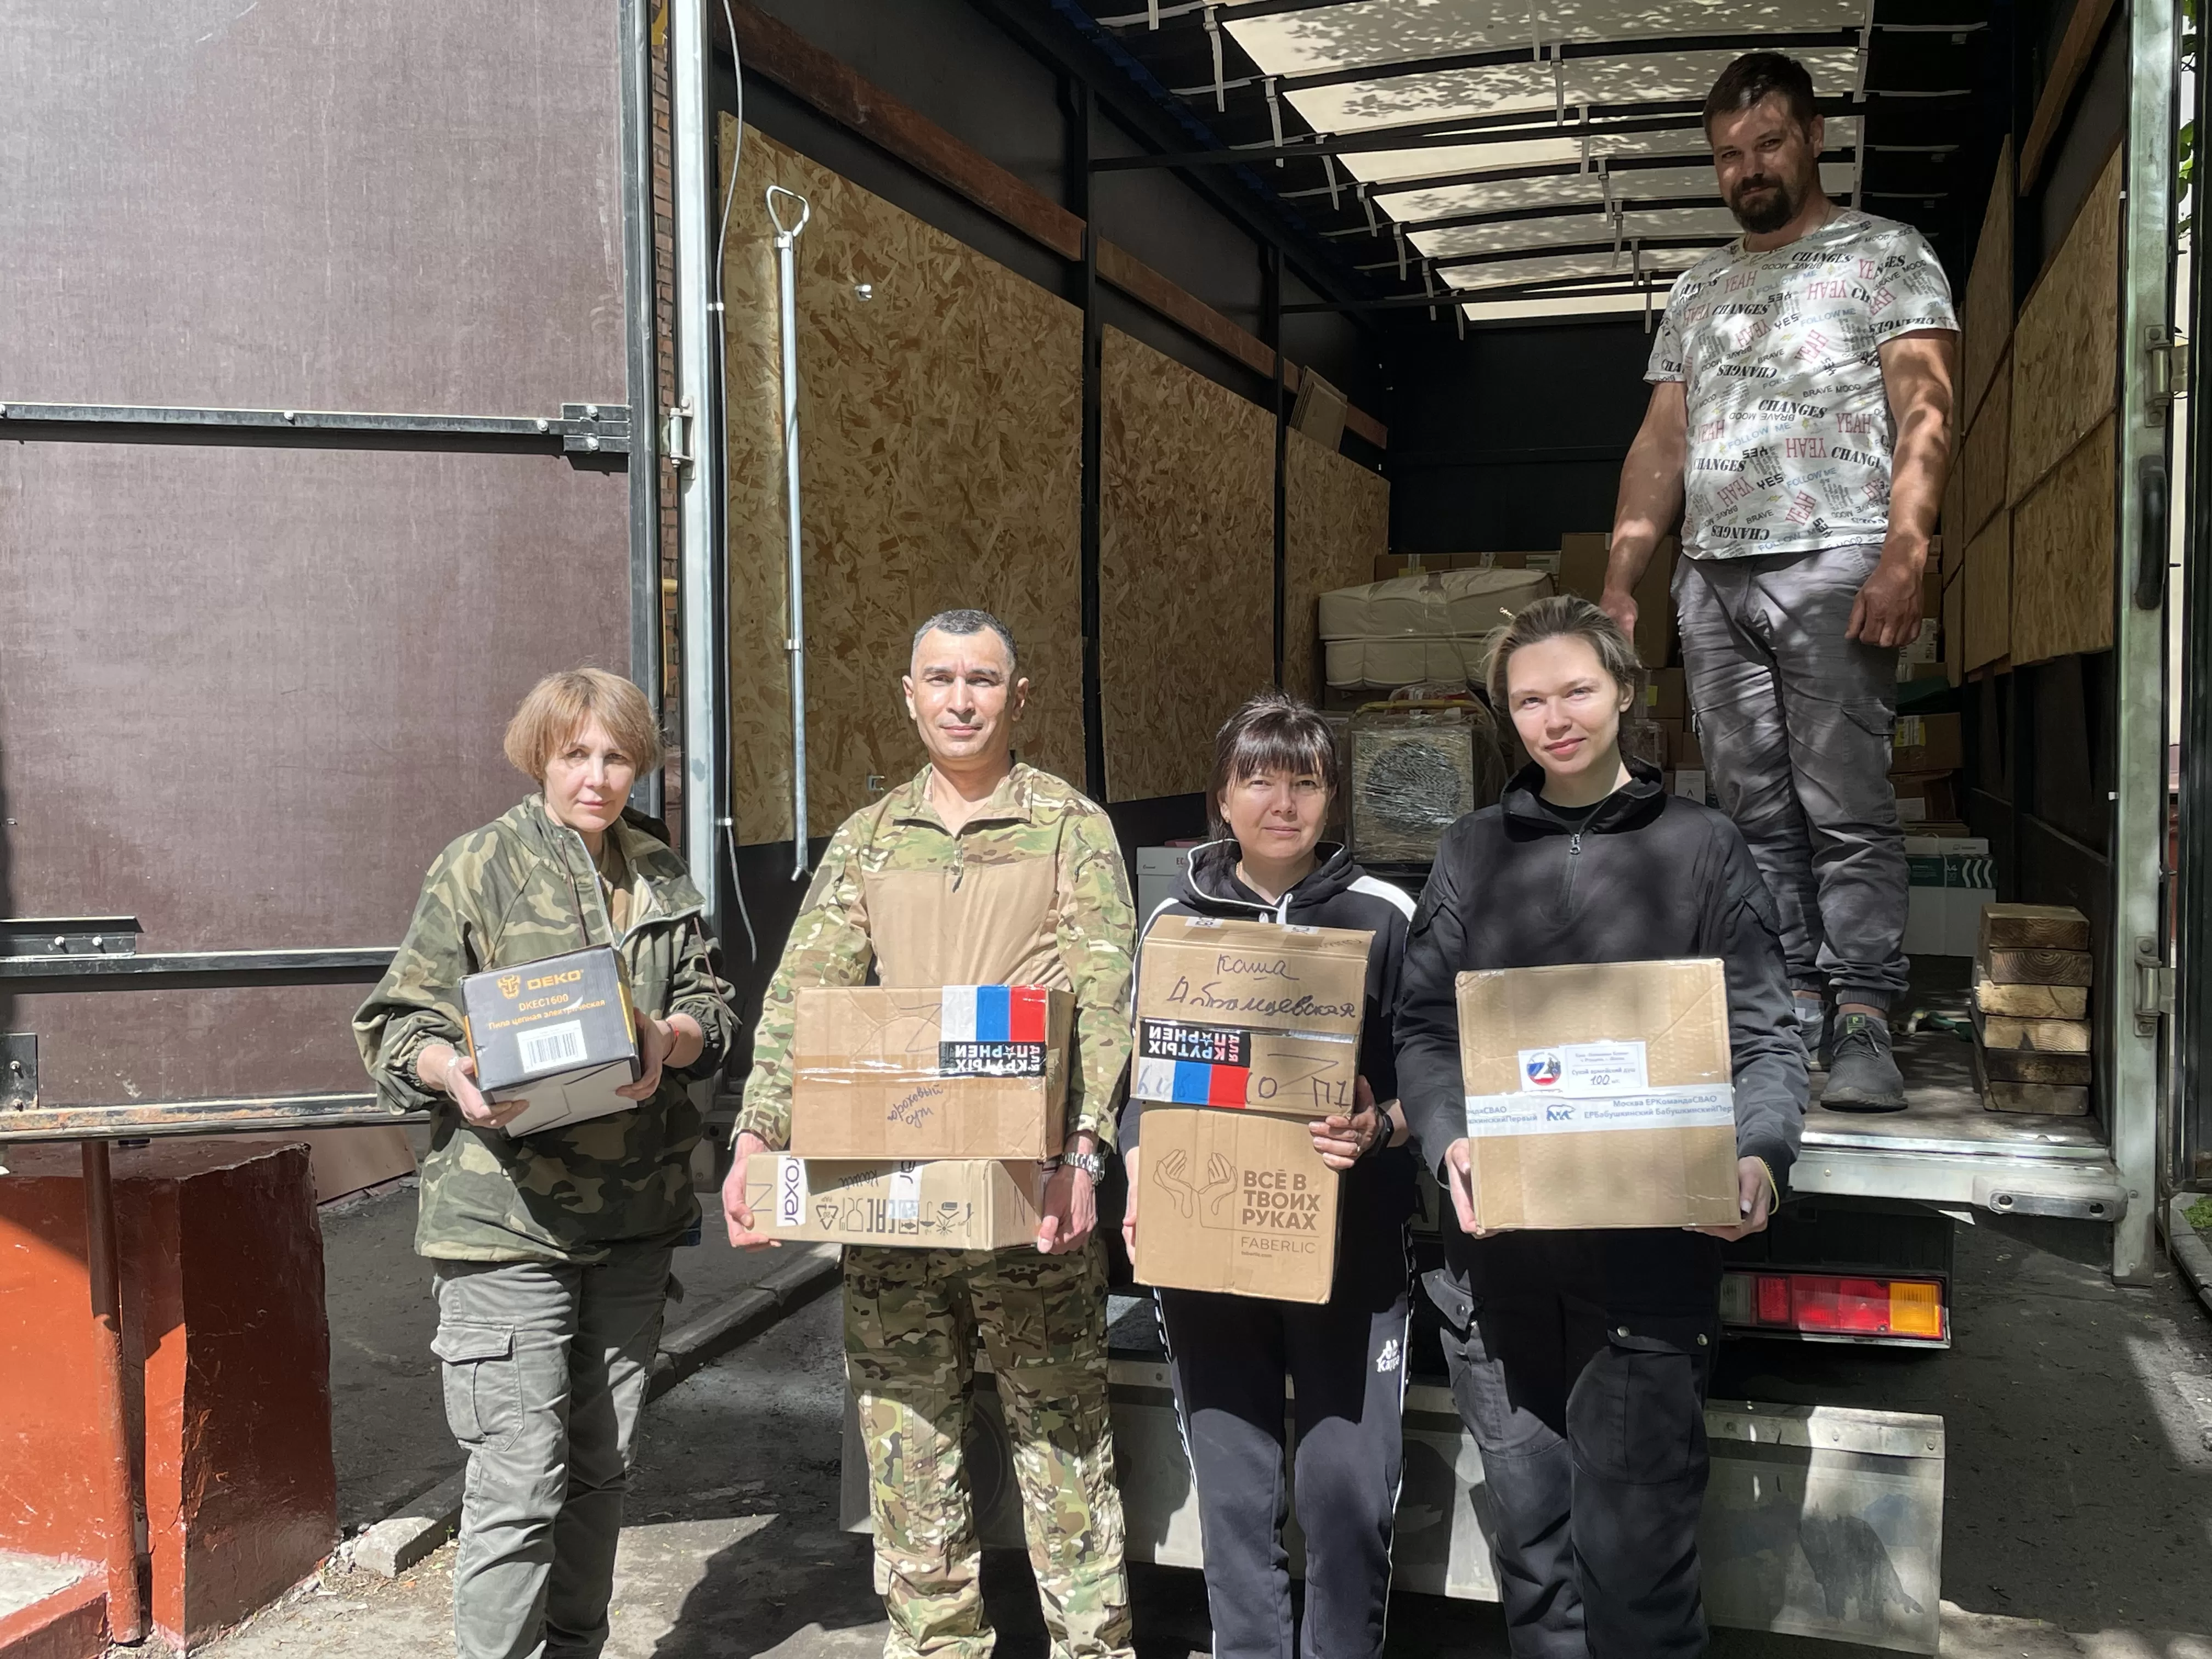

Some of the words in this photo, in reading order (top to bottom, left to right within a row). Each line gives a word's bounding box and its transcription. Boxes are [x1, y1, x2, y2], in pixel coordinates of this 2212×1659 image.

[1792, 252, 1855, 263] CHANGES
[1902, 259, 1927, 273] MOOD
[1724, 270, 1758, 295] YEAH
[1756, 275, 1798, 295] FOLLOW
[1803, 270, 1818, 279] ME
[1807, 280, 1847, 301] YEAH
[1768, 291, 1792, 303] YES
[1712, 303, 1771, 316] CHANGES
[1774, 313, 1799, 330] YES
[1800, 311, 1841, 327] FOLLOW
[1735, 319, 1771, 347] YEAH
[1726, 346, 1753, 360] BRAVE
[1794, 329, 1830, 364] YEAH
[1757, 348, 1785, 364] BRAVE
[1701, 359, 1723, 373] MOOD
[1717, 364, 1778, 379] CHANGES
[1803, 385, 1833, 398] BRAVE
[1836, 383, 1861, 394] MOOD
[1729, 412, 1757, 420] MOOD
[1757, 399, 1829, 419] CHANGES
[1760, 413, 1796, 422] BRAVE
[1696, 419, 1725, 444] YEAH
[1836, 412, 1874, 434] YEAH
[1727, 426, 1769, 449] FOLLOW
[1774, 422, 1792, 433] ME
[1742, 445, 1769, 460] YES
[1785, 437, 1827, 459] YEAH
[1693, 458, 1747, 472] CHANGES
[1756, 473, 1784, 490] YES
[1786, 469, 1822, 489] FOLLOW
[1823, 467, 1837, 476] ME
[1717, 476, 1756, 508] YEAH
[1715, 504, 1739, 521] BRAVE
[1746, 509, 1775, 524] BRAVE
[1785, 489, 1817, 527] YEAH
[1711, 524, 1770, 541] CHANGES
[1758, 532, 1802, 552] FOLLOW
[526, 969, 582, 990] DEKO
[518, 994, 569, 1012] DKEC1600
[488, 1020, 511, 1030] Пила
[512, 1013, 543, 1026] цепная
[1148, 1040, 1226, 1060] КРУТЫХ
[1228, 1034, 1240, 1063] ДЛЯ
[956, 1059, 1028, 1073] КРУТЫХ
[1590, 1075, 1610, 1085] 100
[1645, 1095, 1718, 1105] ЕРКомандаСВАО
[1584, 1109, 1653, 1119] ЕРБабушкинский
[1656, 1104, 1733, 1116] БабушкинскийПер
[1293, 1173, 1306, 1190] В
[1244, 1189, 1321, 1212] ТВОИХ
[1242, 1208, 1317, 1231] РУКАХ
[1241, 1237, 1316, 1254] FABERLIC
